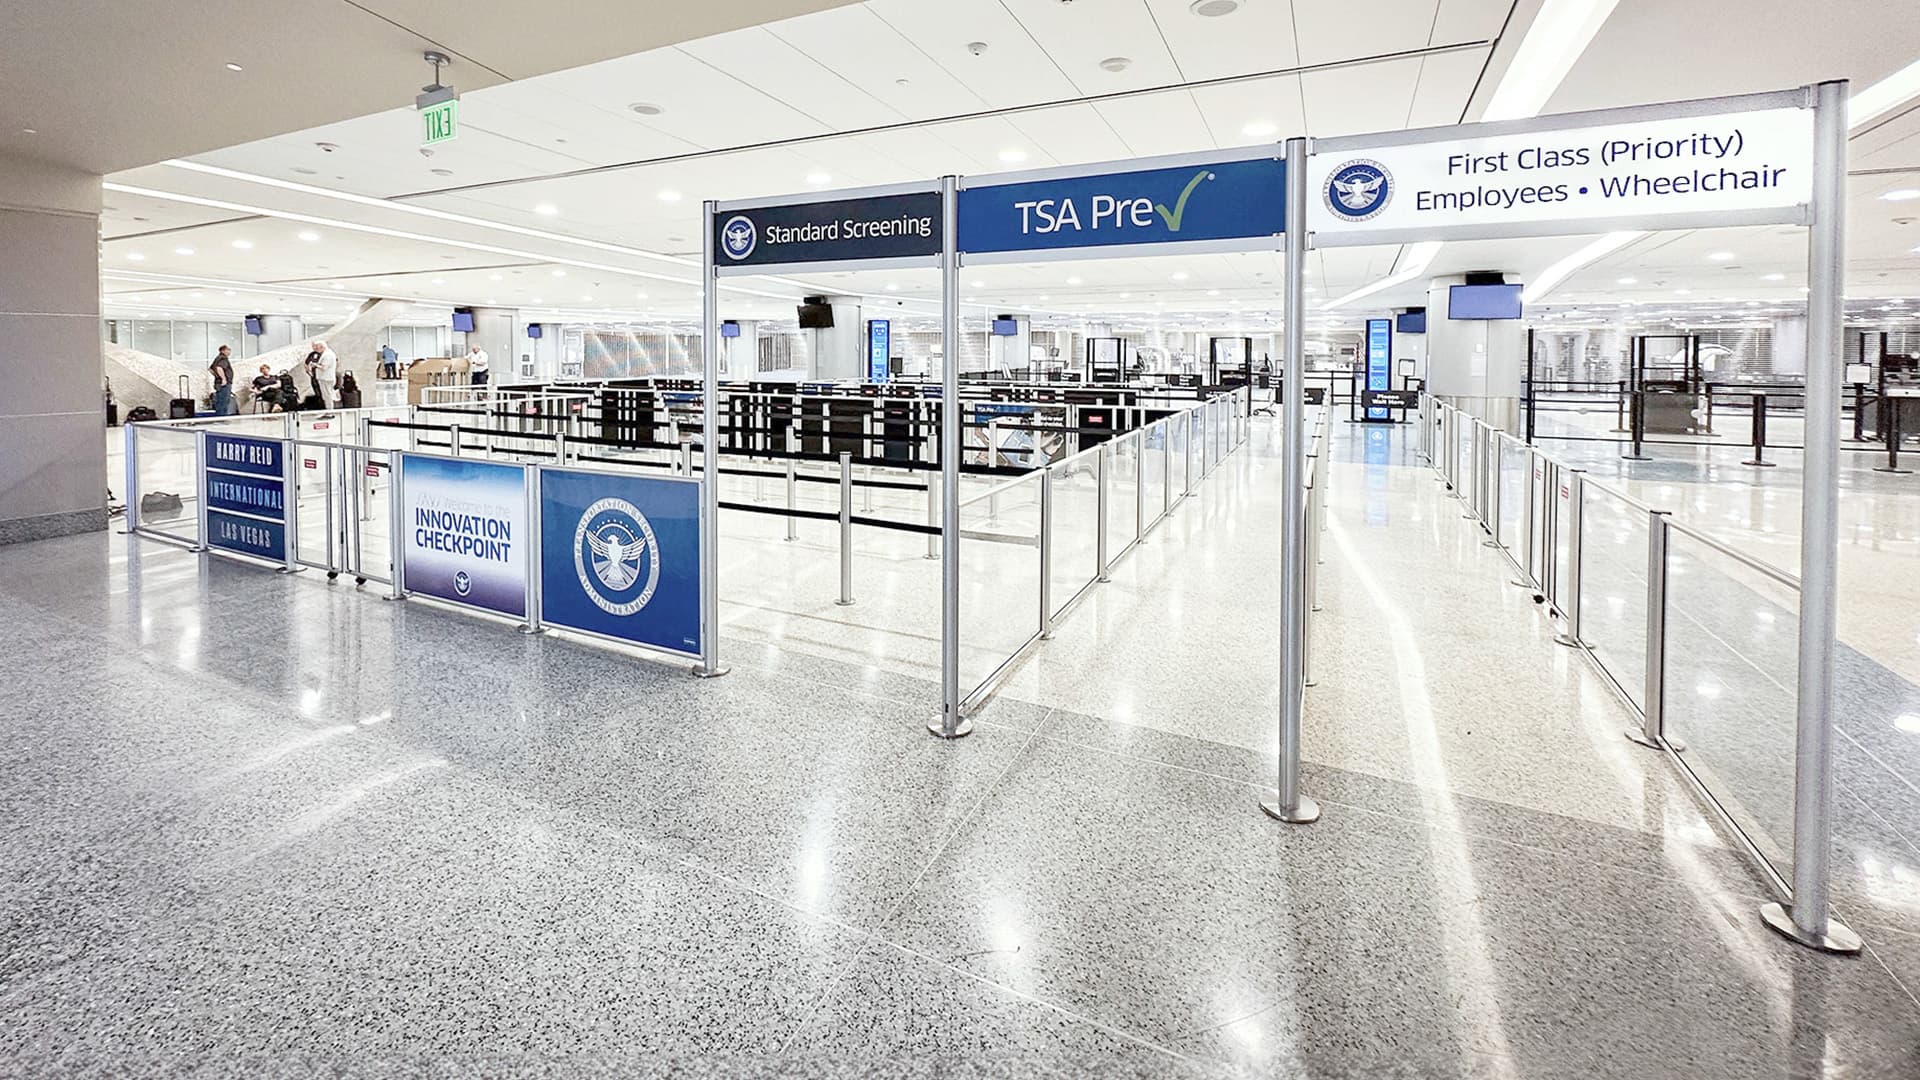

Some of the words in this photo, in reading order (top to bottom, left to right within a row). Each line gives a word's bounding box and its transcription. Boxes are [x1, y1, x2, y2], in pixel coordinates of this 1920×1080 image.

[1447, 151, 1509, 177] First
[1517, 144, 1590, 170] Class
[1600, 128, 1744, 167] (Priority)
[1416, 181, 1568, 212] Employees
[1600, 163, 1787, 197] Wheelchair
[766, 219, 839, 245] Standard
[843, 214, 932, 238] Screening
[1014, 197, 1082, 235] TSA
[1091, 194, 1153, 230] Pre
[216, 441, 246, 463] HARRY
[249, 445, 273, 466] REID
[209, 480, 283, 510] INTERNATIONAL
[220, 520, 238, 541] LAS
[240, 524, 272, 549] VEGAS
[415, 506, 511, 541] INNOVATION
[415, 528, 511, 563] CHECKPOINT
